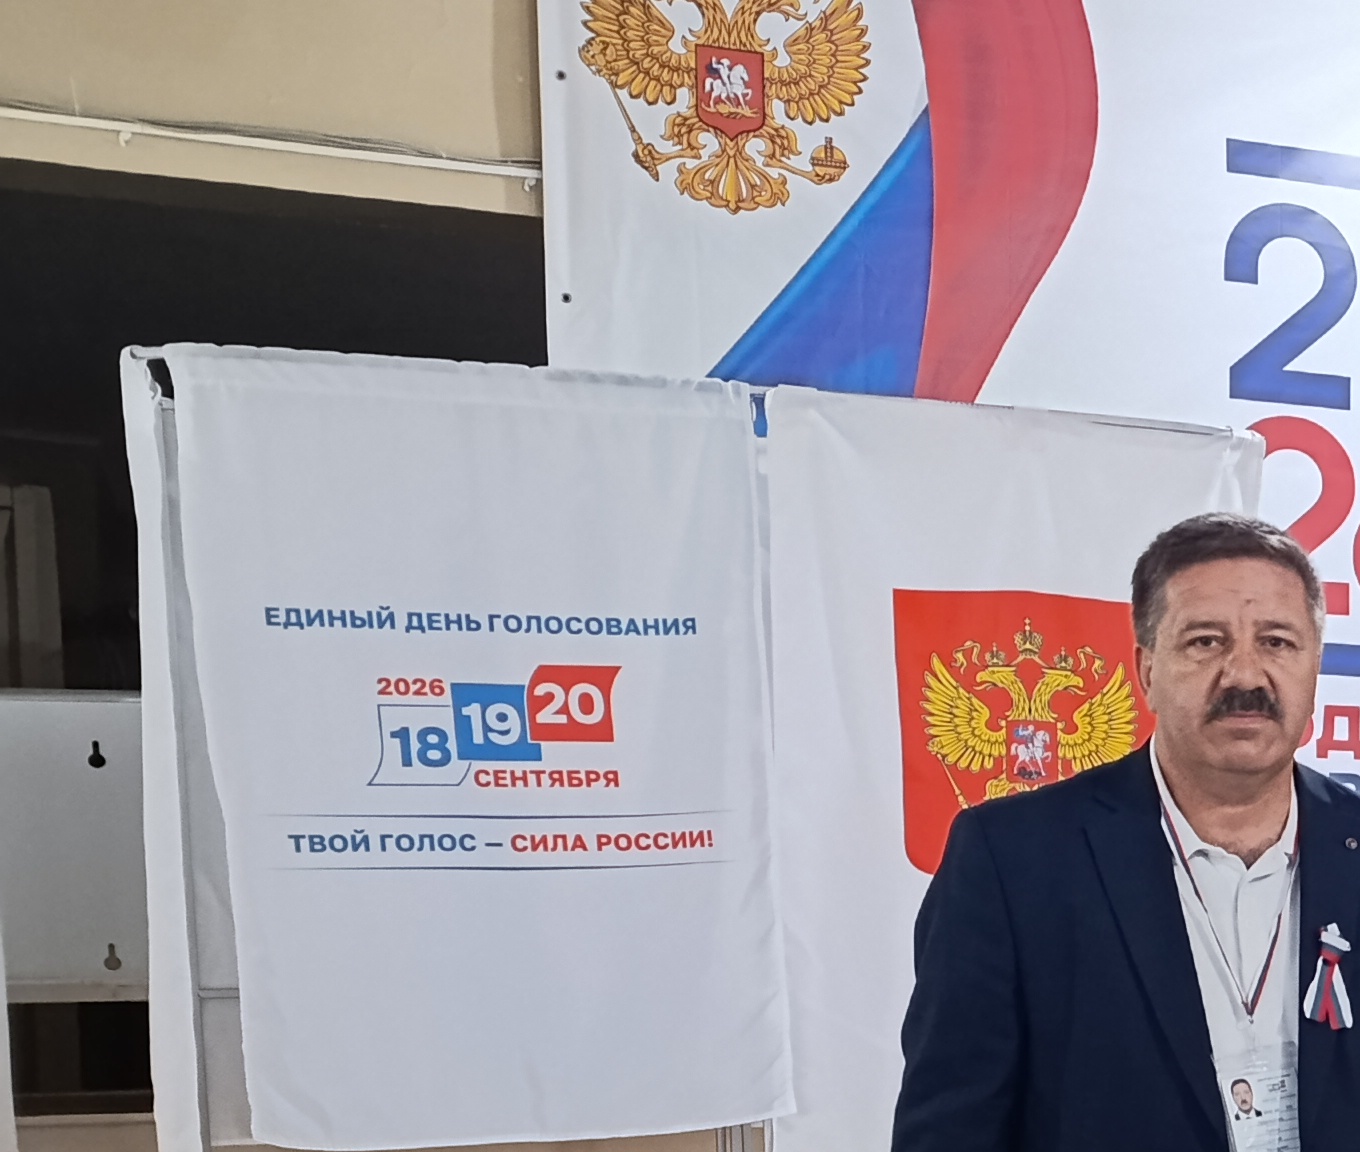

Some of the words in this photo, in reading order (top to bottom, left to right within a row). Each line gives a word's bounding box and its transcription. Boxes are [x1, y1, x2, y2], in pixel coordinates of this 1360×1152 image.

[264, 605, 396, 631] ЕДИНЫЙ
[404, 611, 482, 634] ДЕНЬ
[487, 613, 697, 636] ГОЛОСОВАНИЯ
[376, 677, 446, 697] 2026
[389, 725, 453, 768] 18
[461, 702, 522, 746] 19
[532, 681, 605, 725] 20
[473, 769, 620, 788] СЕНТЯБРЯ
[287, 828, 371, 854] ТВОЙ
[379, 833, 477, 853] ГОЛОС
[510, 833, 589, 853] СИЛА
[596, 829, 714, 852] РОССИИ!
